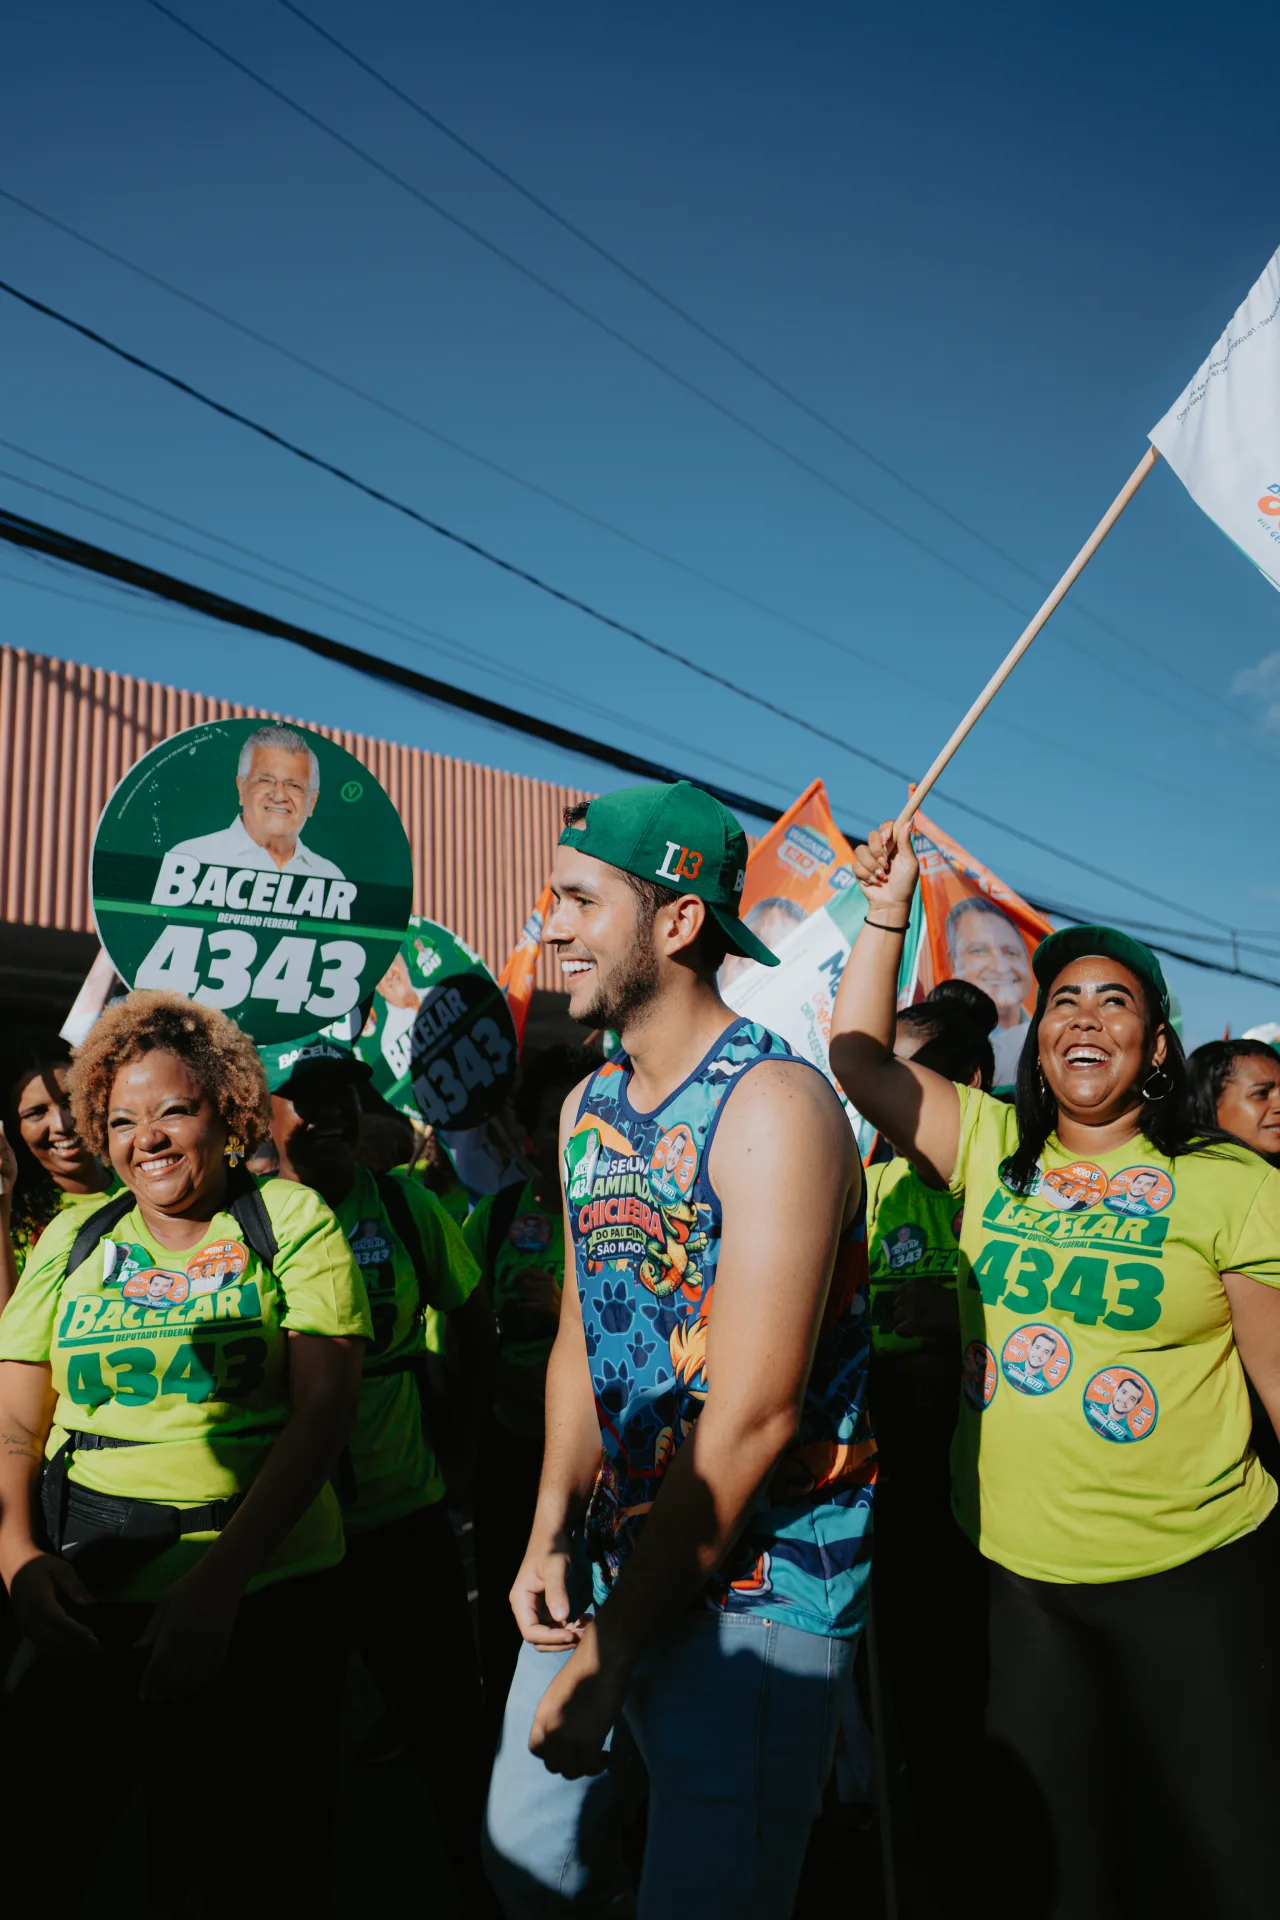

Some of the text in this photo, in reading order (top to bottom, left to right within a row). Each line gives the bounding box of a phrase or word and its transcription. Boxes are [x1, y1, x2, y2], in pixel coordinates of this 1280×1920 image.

[788, 827, 832, 861] WAGNER
[151, 852, 358, 921] BACELAR
[217, 912, 298, 931] DEPUTADO FEDERAL
[134, 924, 367, 1018] 4343
[384, 987, 469, 1081] BACELAR
[278, 1044, 344, 1070] BACELAR
[413, 1016, 512, 1125] 4343
[595, 1229, 609, 1241] DO
[596, 1241, 617, 1256] SÃO
[1060, 1240, 1090, 1250] FEDERAL
[967, 1239, 1165, 1332] 4343
[65, 1287, 242, 1340] BACELAR
[115, 1328, 194, 1343] DEPUTADO FEDERAL
[67, 1336, 268, 1408] 4343
